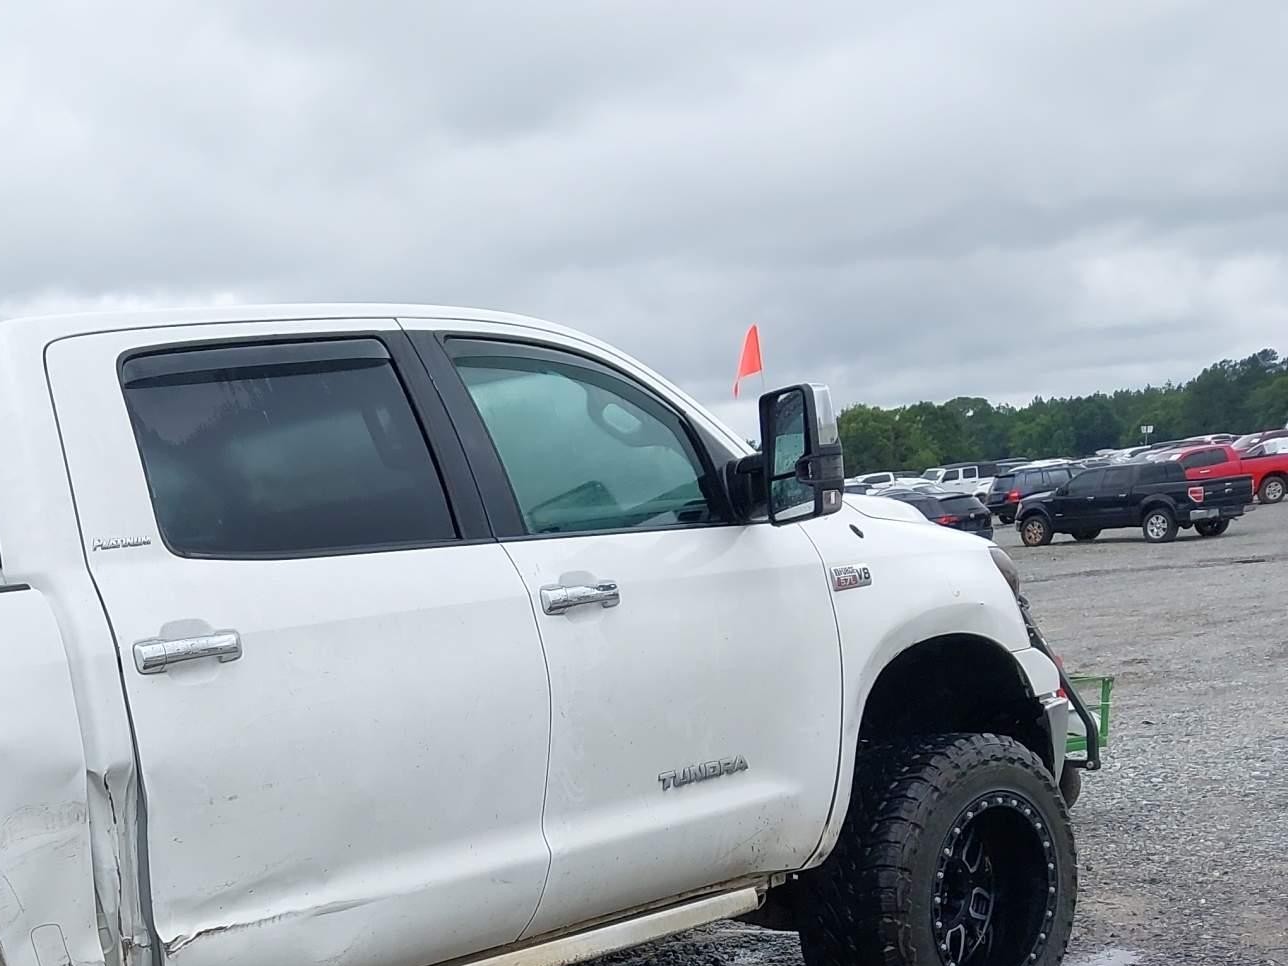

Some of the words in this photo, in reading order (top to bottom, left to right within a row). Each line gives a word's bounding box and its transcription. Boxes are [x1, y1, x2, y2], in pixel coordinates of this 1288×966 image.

[92, 536, 152, 552] PLATINUM
[856, 566, 872, 581] V8
[657, 754, 749, 791] TUNDRA
